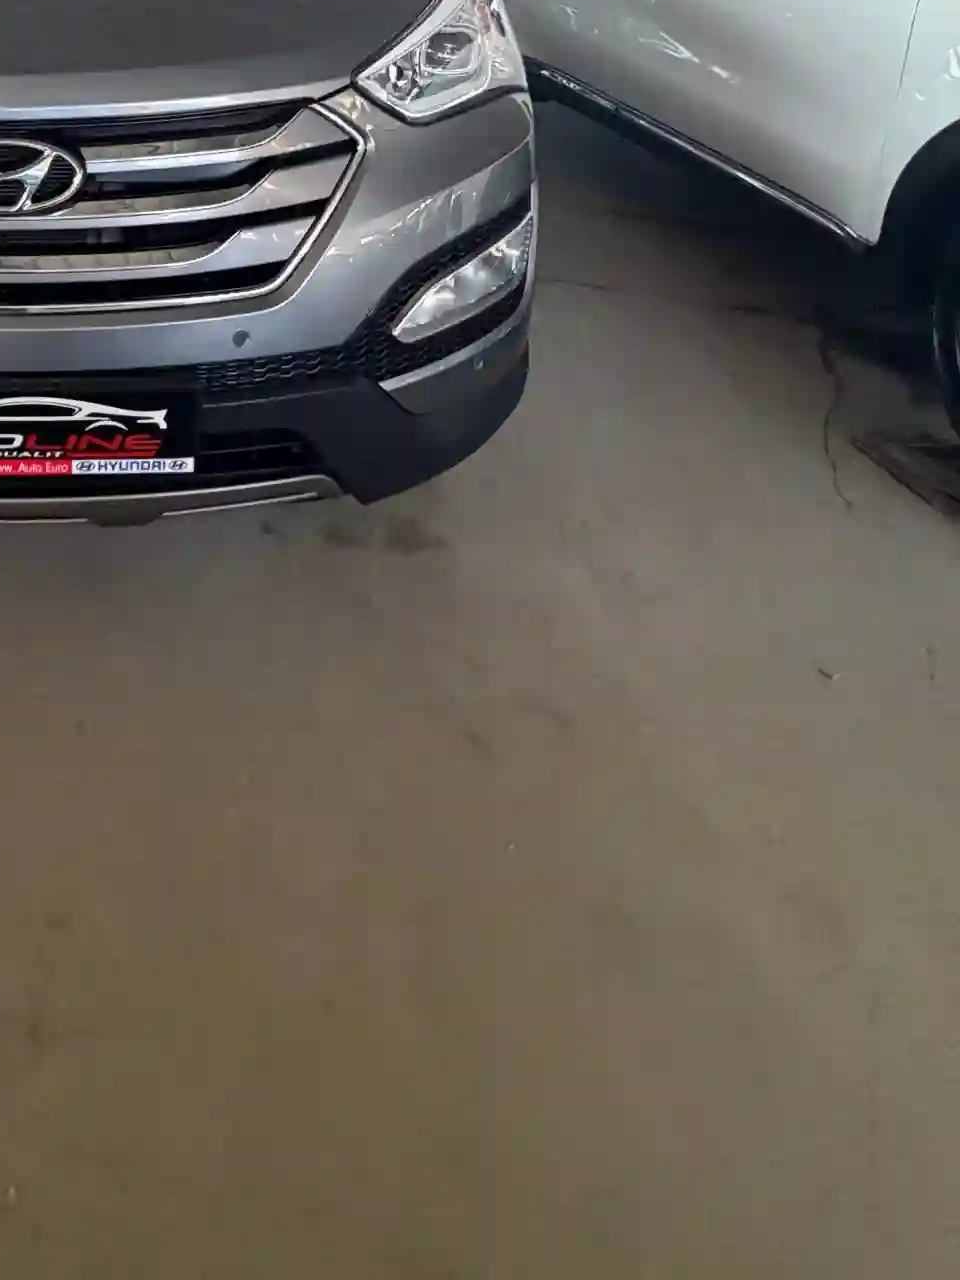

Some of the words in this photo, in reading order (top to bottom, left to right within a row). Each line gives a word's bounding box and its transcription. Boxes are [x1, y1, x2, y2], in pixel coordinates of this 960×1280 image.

[19, 461, 43, 473] Auto
[45, 461, 69, 473] Euro
[97, 460, 166, 472] HYUNDAI
